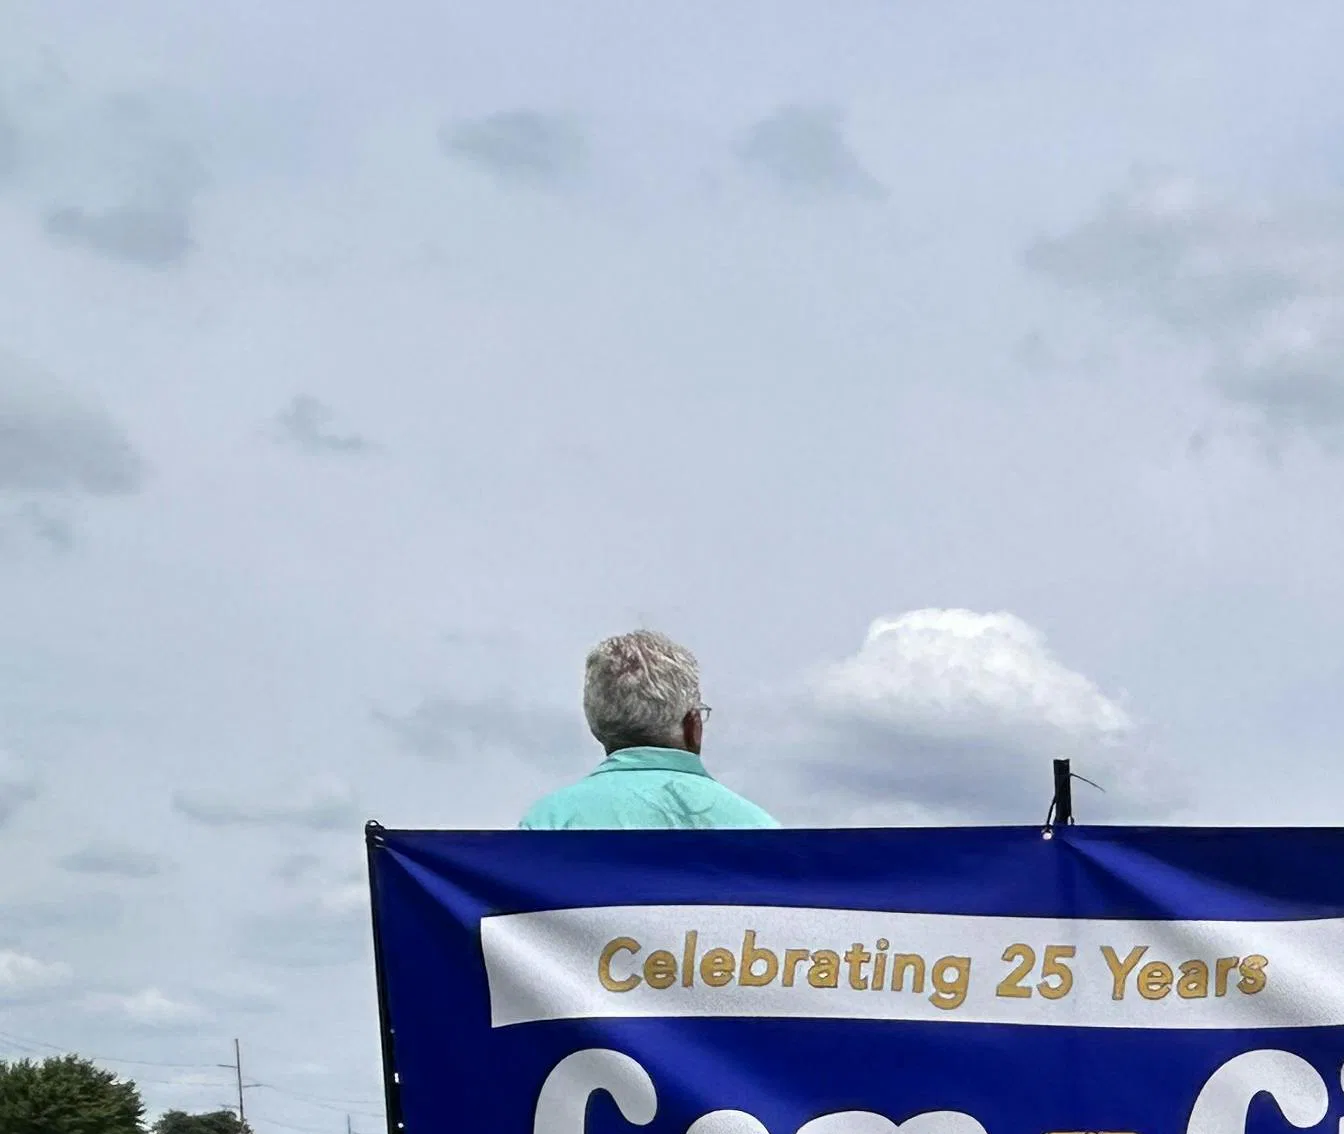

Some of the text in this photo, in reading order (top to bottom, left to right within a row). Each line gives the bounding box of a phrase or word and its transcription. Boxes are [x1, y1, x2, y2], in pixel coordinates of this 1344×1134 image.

[597, 930, 1269, 1010] Celebrating 25 Years
